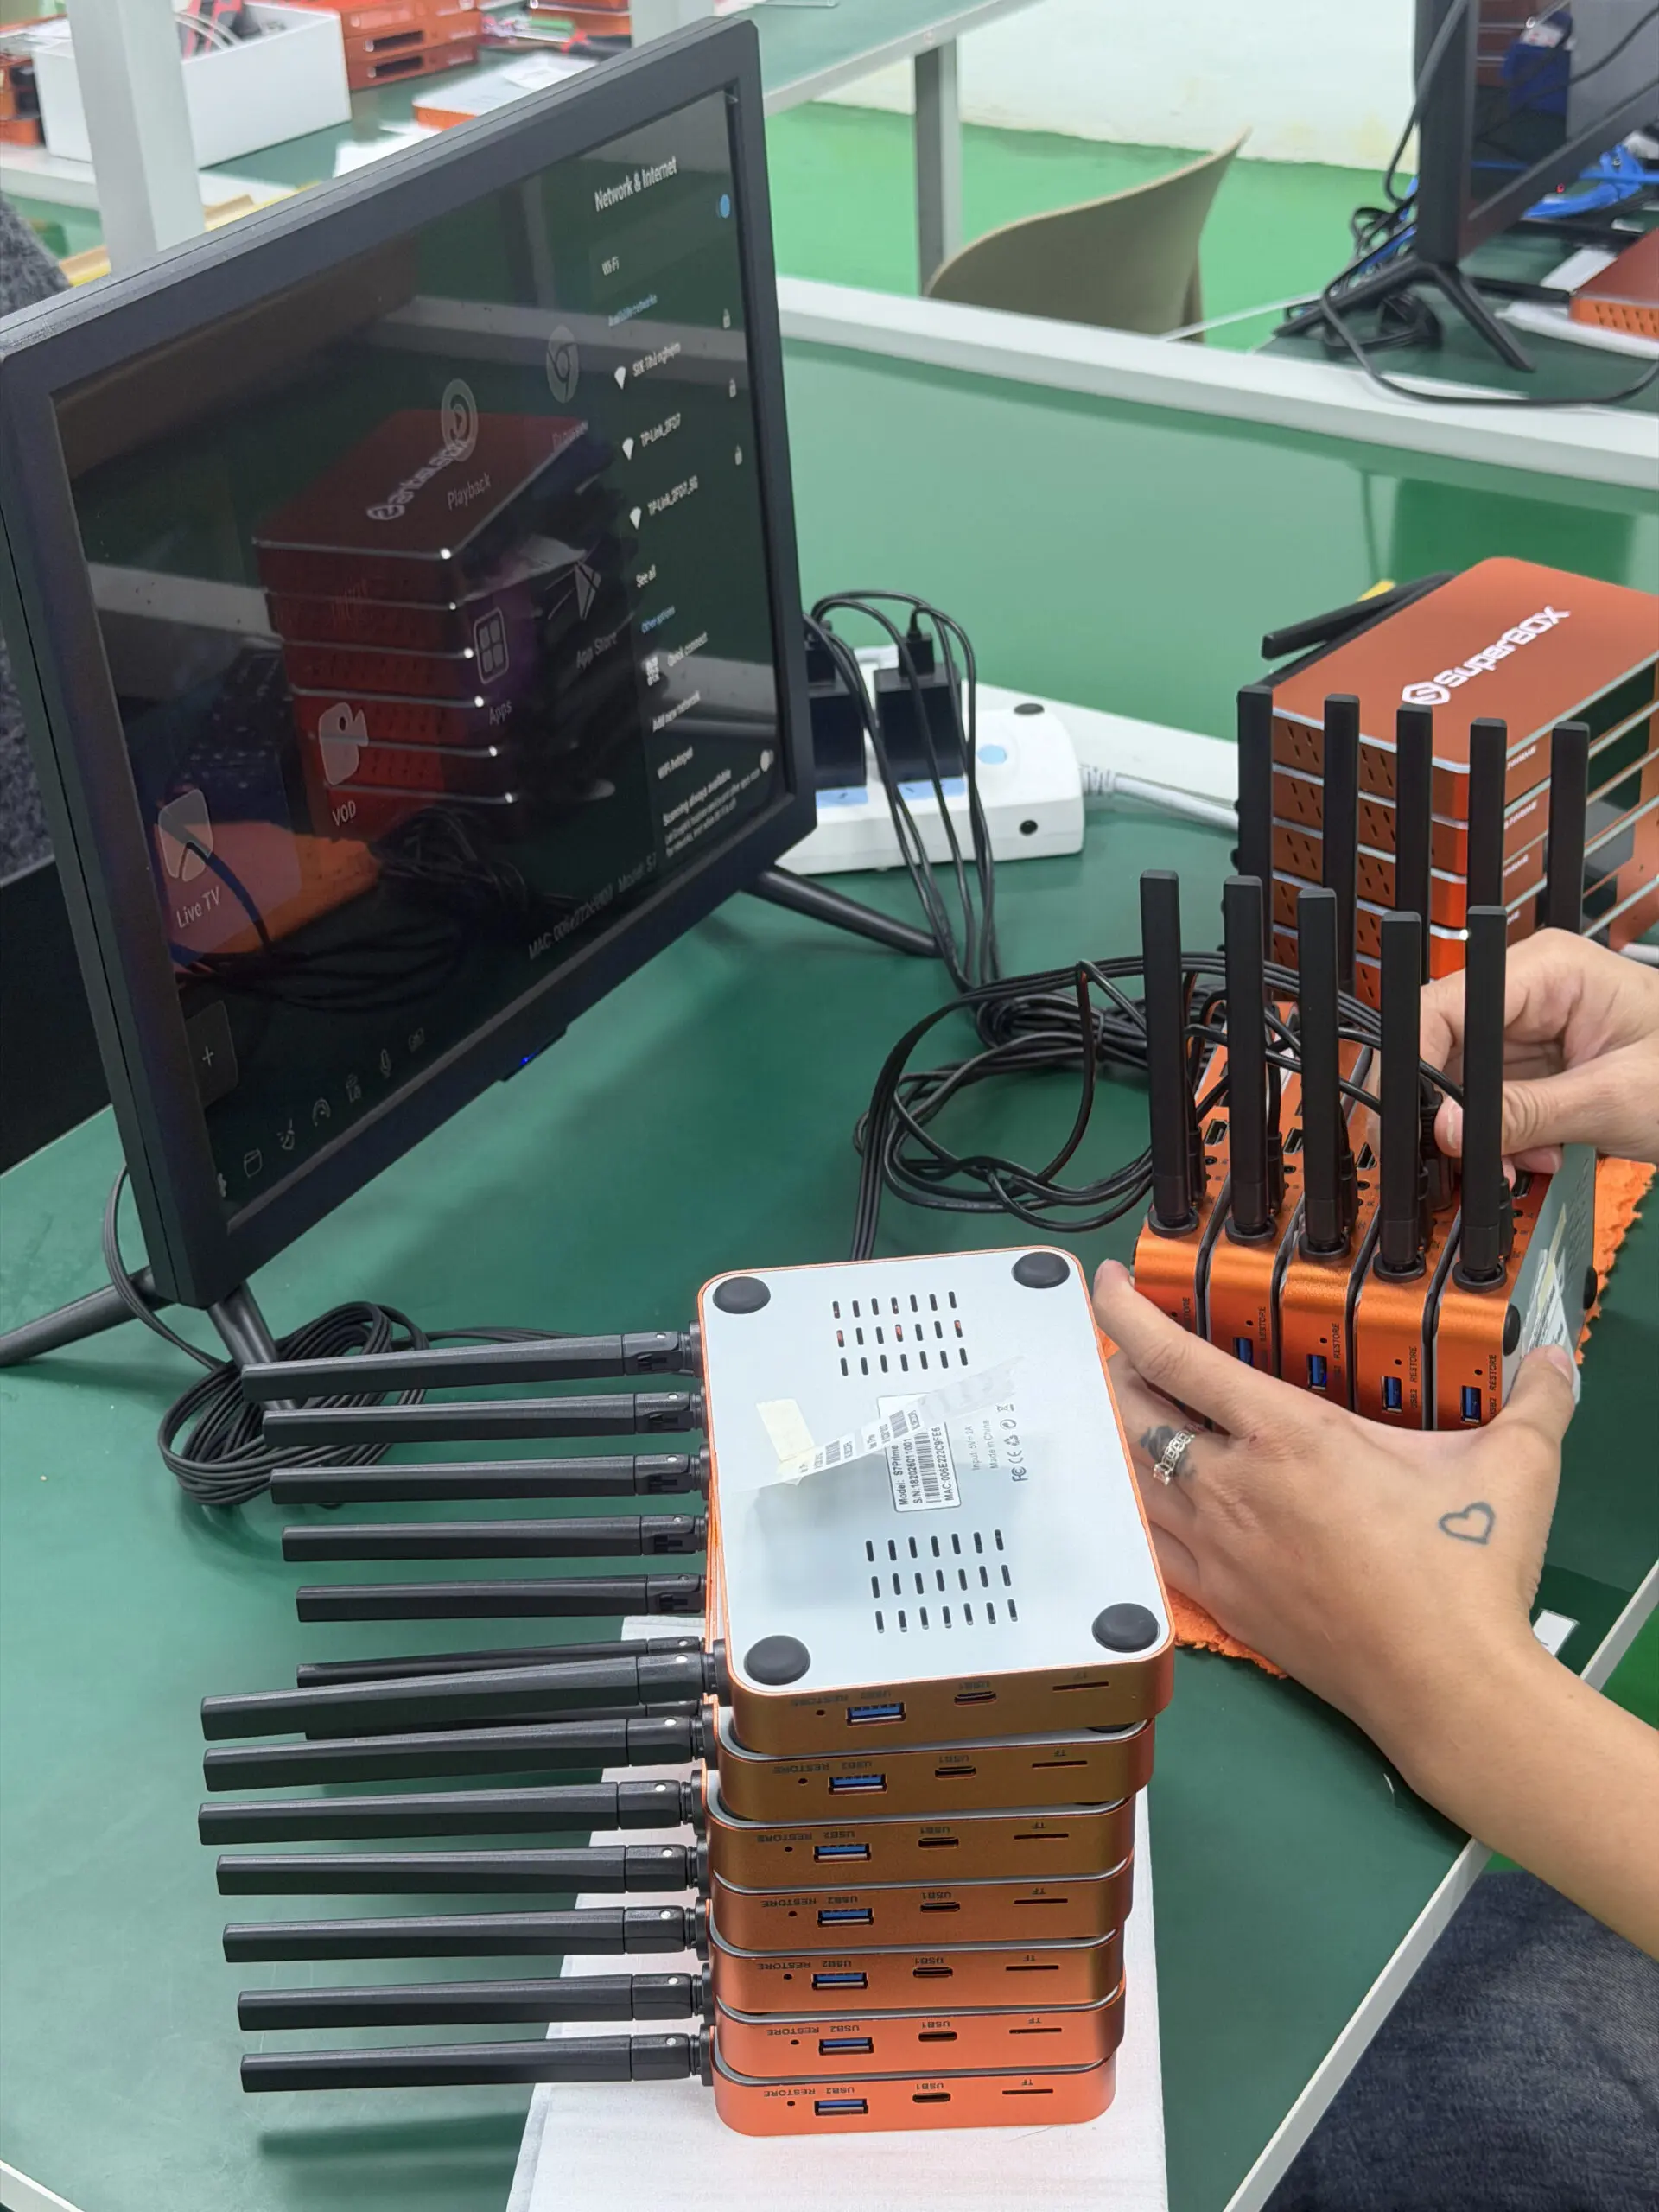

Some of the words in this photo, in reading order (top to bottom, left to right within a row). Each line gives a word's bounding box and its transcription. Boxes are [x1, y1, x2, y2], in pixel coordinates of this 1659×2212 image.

[594, 174, 633, 212] Network
[633, 170, 641, 193] &
[641, 155, 677, 188] Internet
[447, 472, 492, 511] Playback
[636, 573, 648, 588] See
[576, 647, 594, 671] App
[594, 632, 618, 655] Store
[489, 699, 512, 725] Apps
[332, 799, 357, 827] VOD
[176, 901, 202, 929] Live
[202, 886, 222, 910] TV
[1332, 1323, 1341, 1360] RESTORE
[1409, 1346, 1418, 1382] RESTORE
[1488, 1354, 1497, 1391] RESTORE
[983, 1420, 994, 1441] China
[891, 1445, 904, 1476] S7Prime
[988, 1449, 999, 1469] Made
[894, 1479, 908, 1505] Model:
[938, 1755, 969, 1764] USB1
[823, 1830, 855, 1840] USB2
[919, 1826, 950, 1834] USB1
[756, 1832, 813, 1843] RESTORE
[826, 1895, 859, 1905] USB2
[921, 1891, 952, 1900] USB1
[761, 1897, 817, 1908] RESTORE
[756, 1961, 811, 1971] RESTORE
[821, 1959, 852, 1968] USB2
[914, 1956, 944, 1965] USB1
[830, 2024, 860, 2033] USB2
[920, 2020, 950, 2029] USB1
[766, 2026, 820, 2037] RESTORE
[826, 2086, 855, 2094] USB2
[916, 2082, 944, 2091] USB1
[763, 2088, 817, 2098] RESTORE
